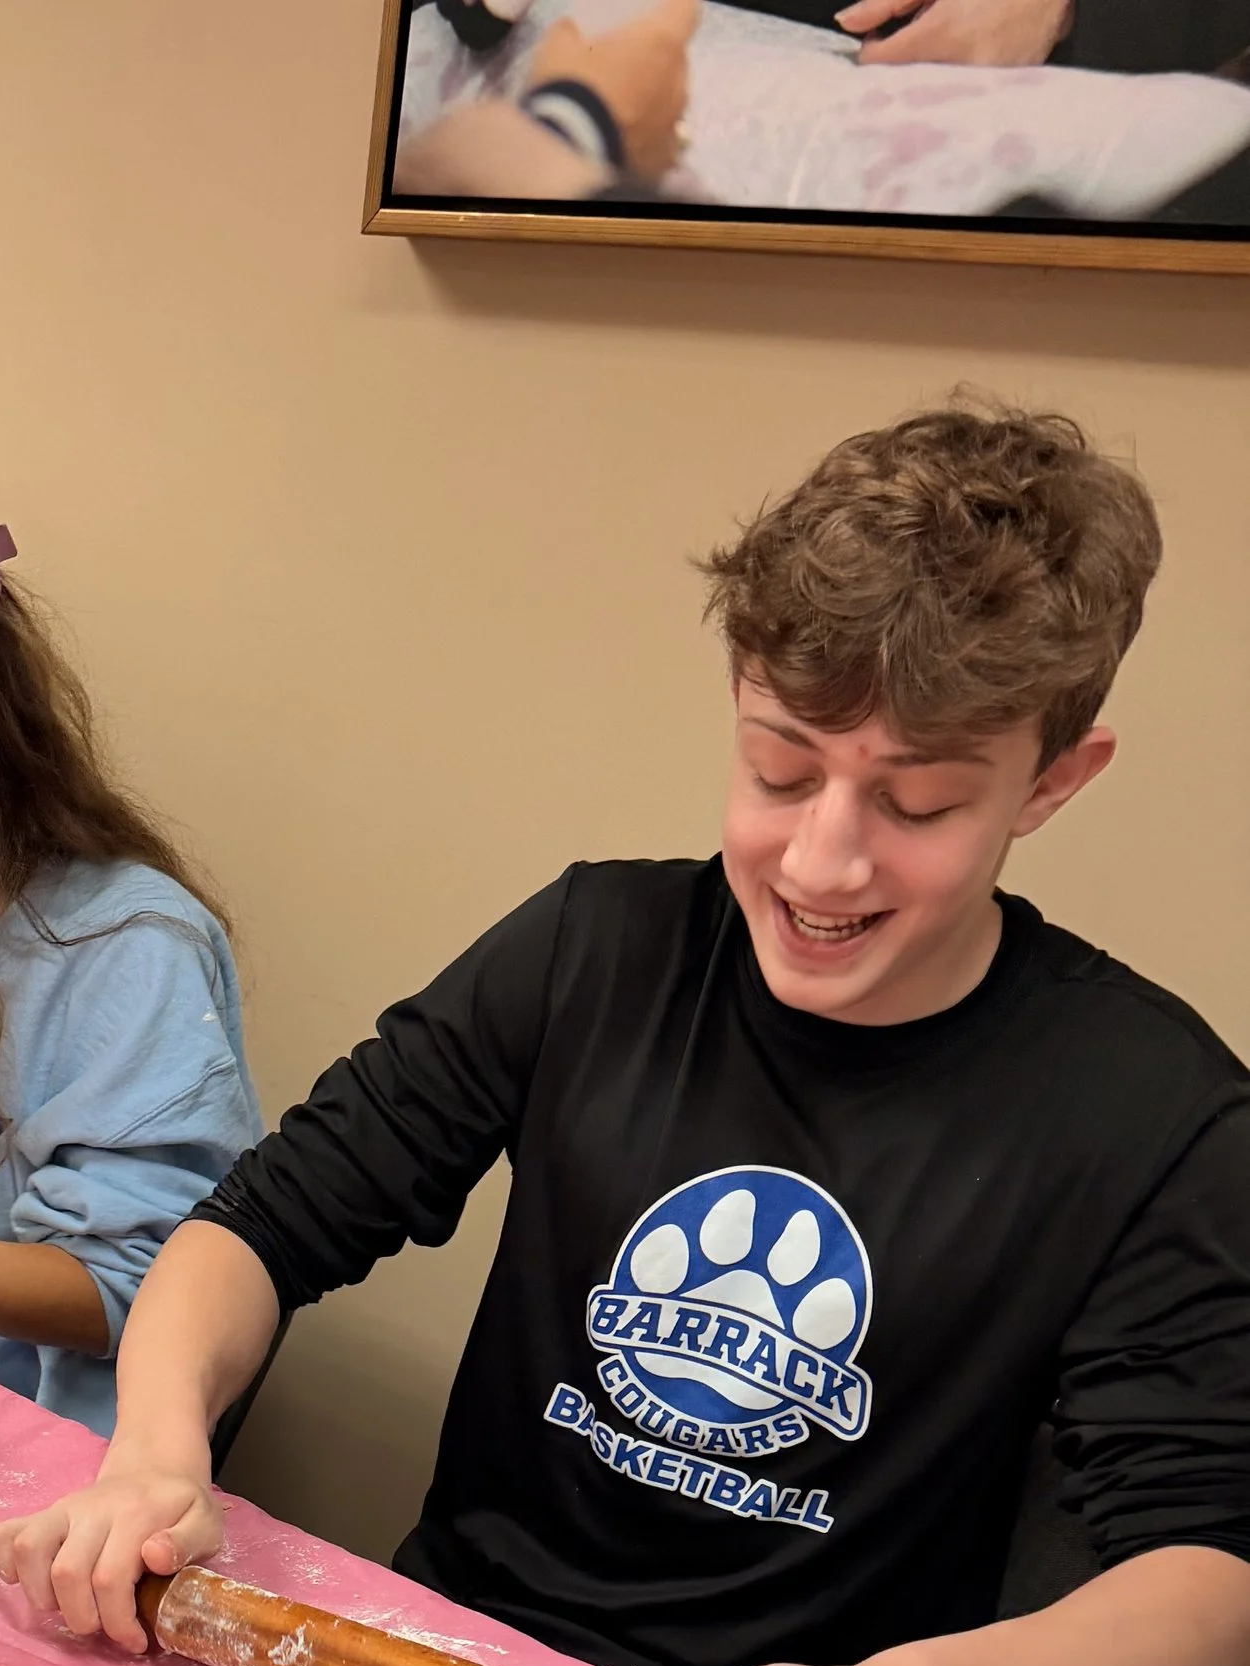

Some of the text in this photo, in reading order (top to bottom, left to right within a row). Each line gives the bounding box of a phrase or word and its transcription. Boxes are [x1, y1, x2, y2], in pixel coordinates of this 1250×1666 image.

[591, 1297, 857, 1422] BARRACK
[598, 1355, 810, 1456] COUGARS
[545, 1384, 833, 1532] BASKETBALL
